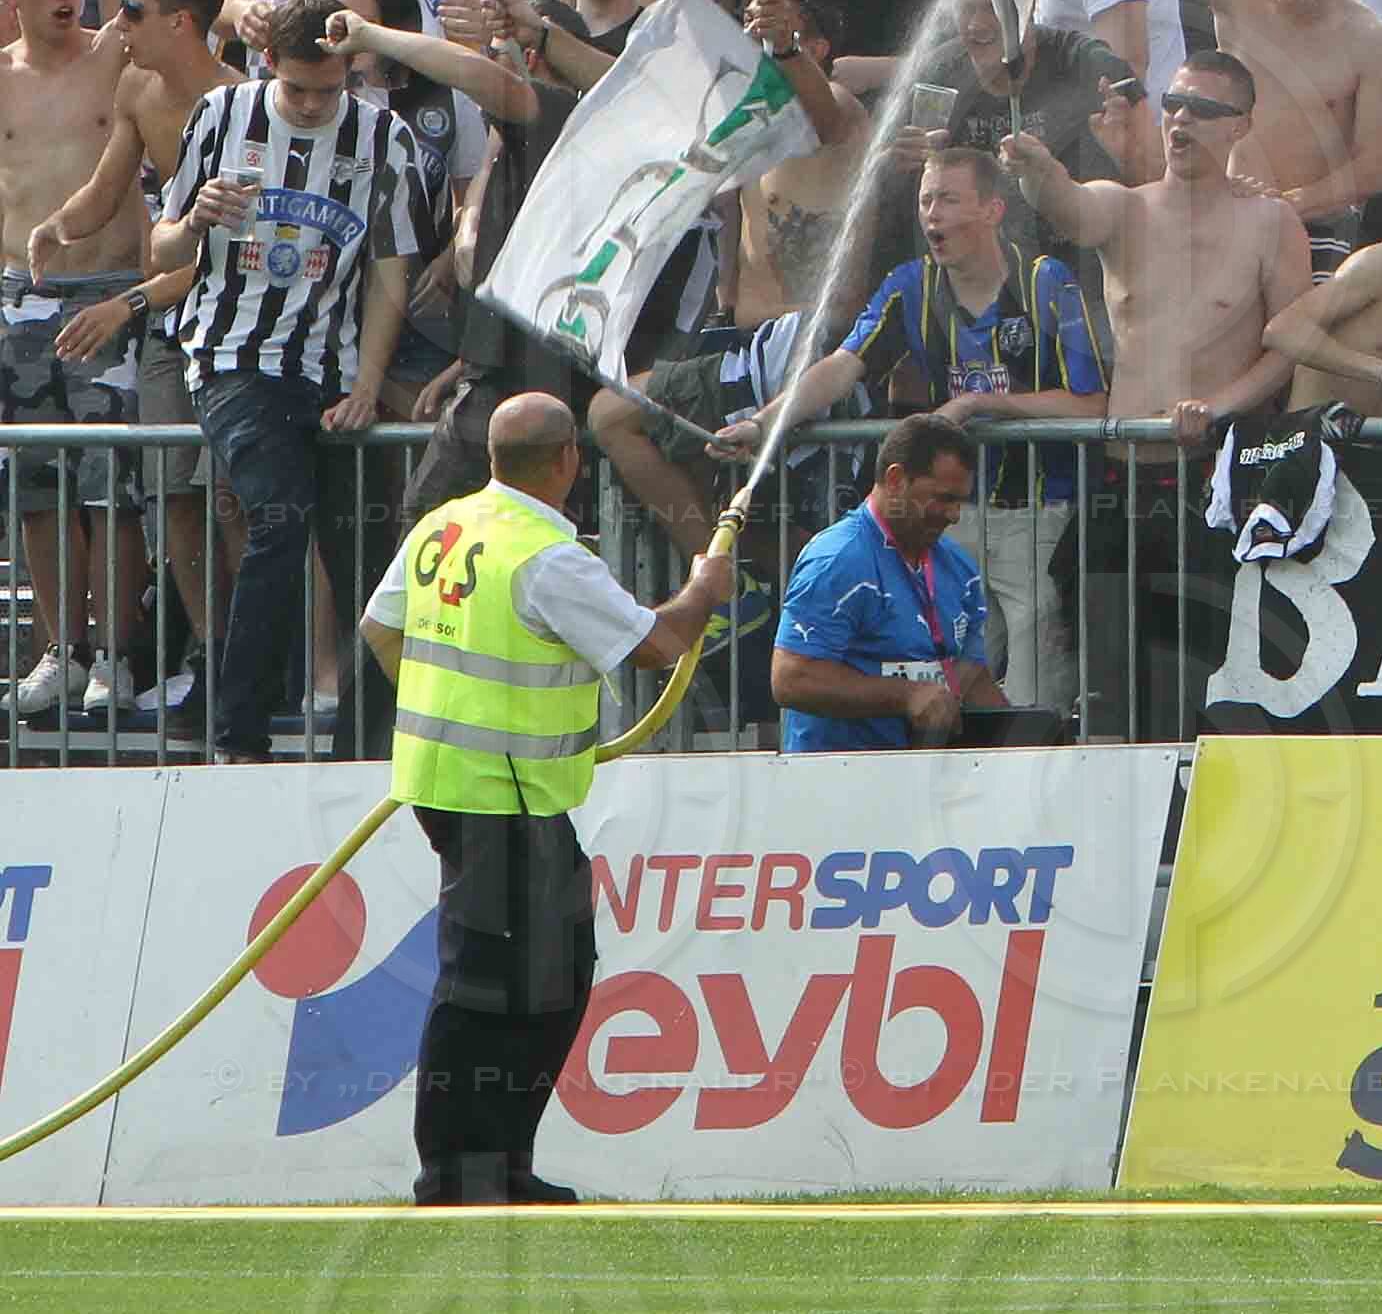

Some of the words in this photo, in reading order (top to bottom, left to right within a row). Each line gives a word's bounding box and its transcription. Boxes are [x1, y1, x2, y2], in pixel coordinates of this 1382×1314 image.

[416, 521, 485, 607] G4S
[589, 844, 1075, 934] NTERSPORT
[554, 929, 1047, 1136] eybl
